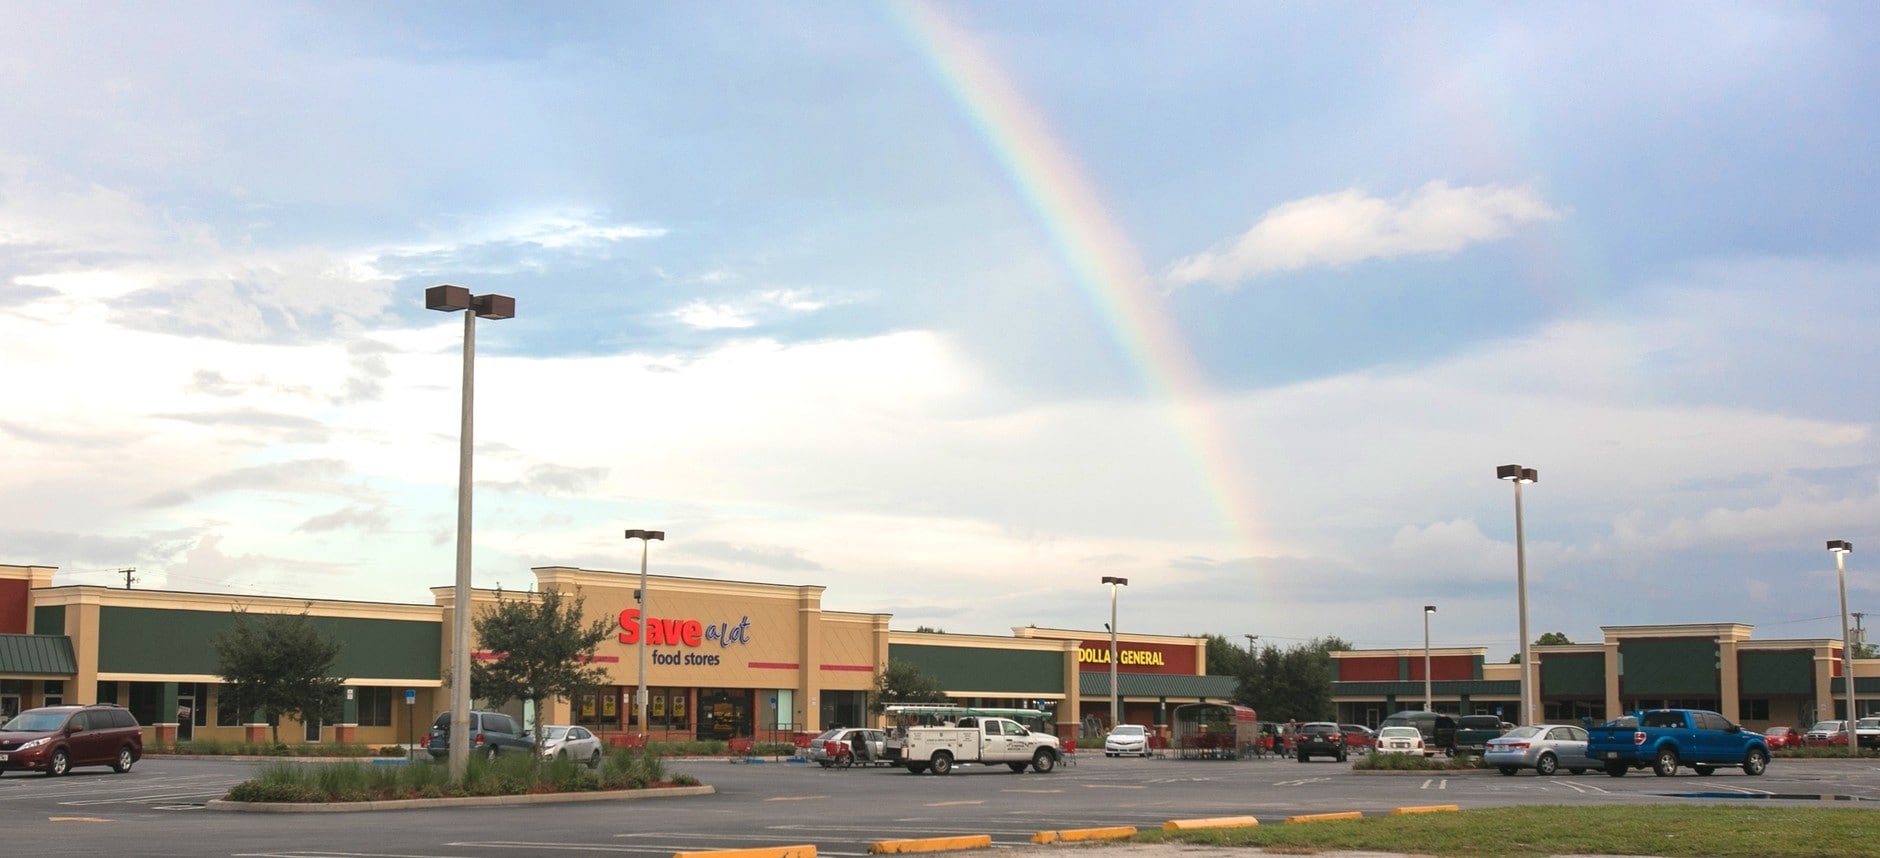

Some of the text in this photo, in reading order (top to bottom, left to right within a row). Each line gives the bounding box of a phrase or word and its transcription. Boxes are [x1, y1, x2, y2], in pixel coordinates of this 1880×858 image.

[619, 608, 703, 647] Save
[652, 649, 720, 666] food stores
[1079, 647, 1164, 666] DOLLA GENERAL
